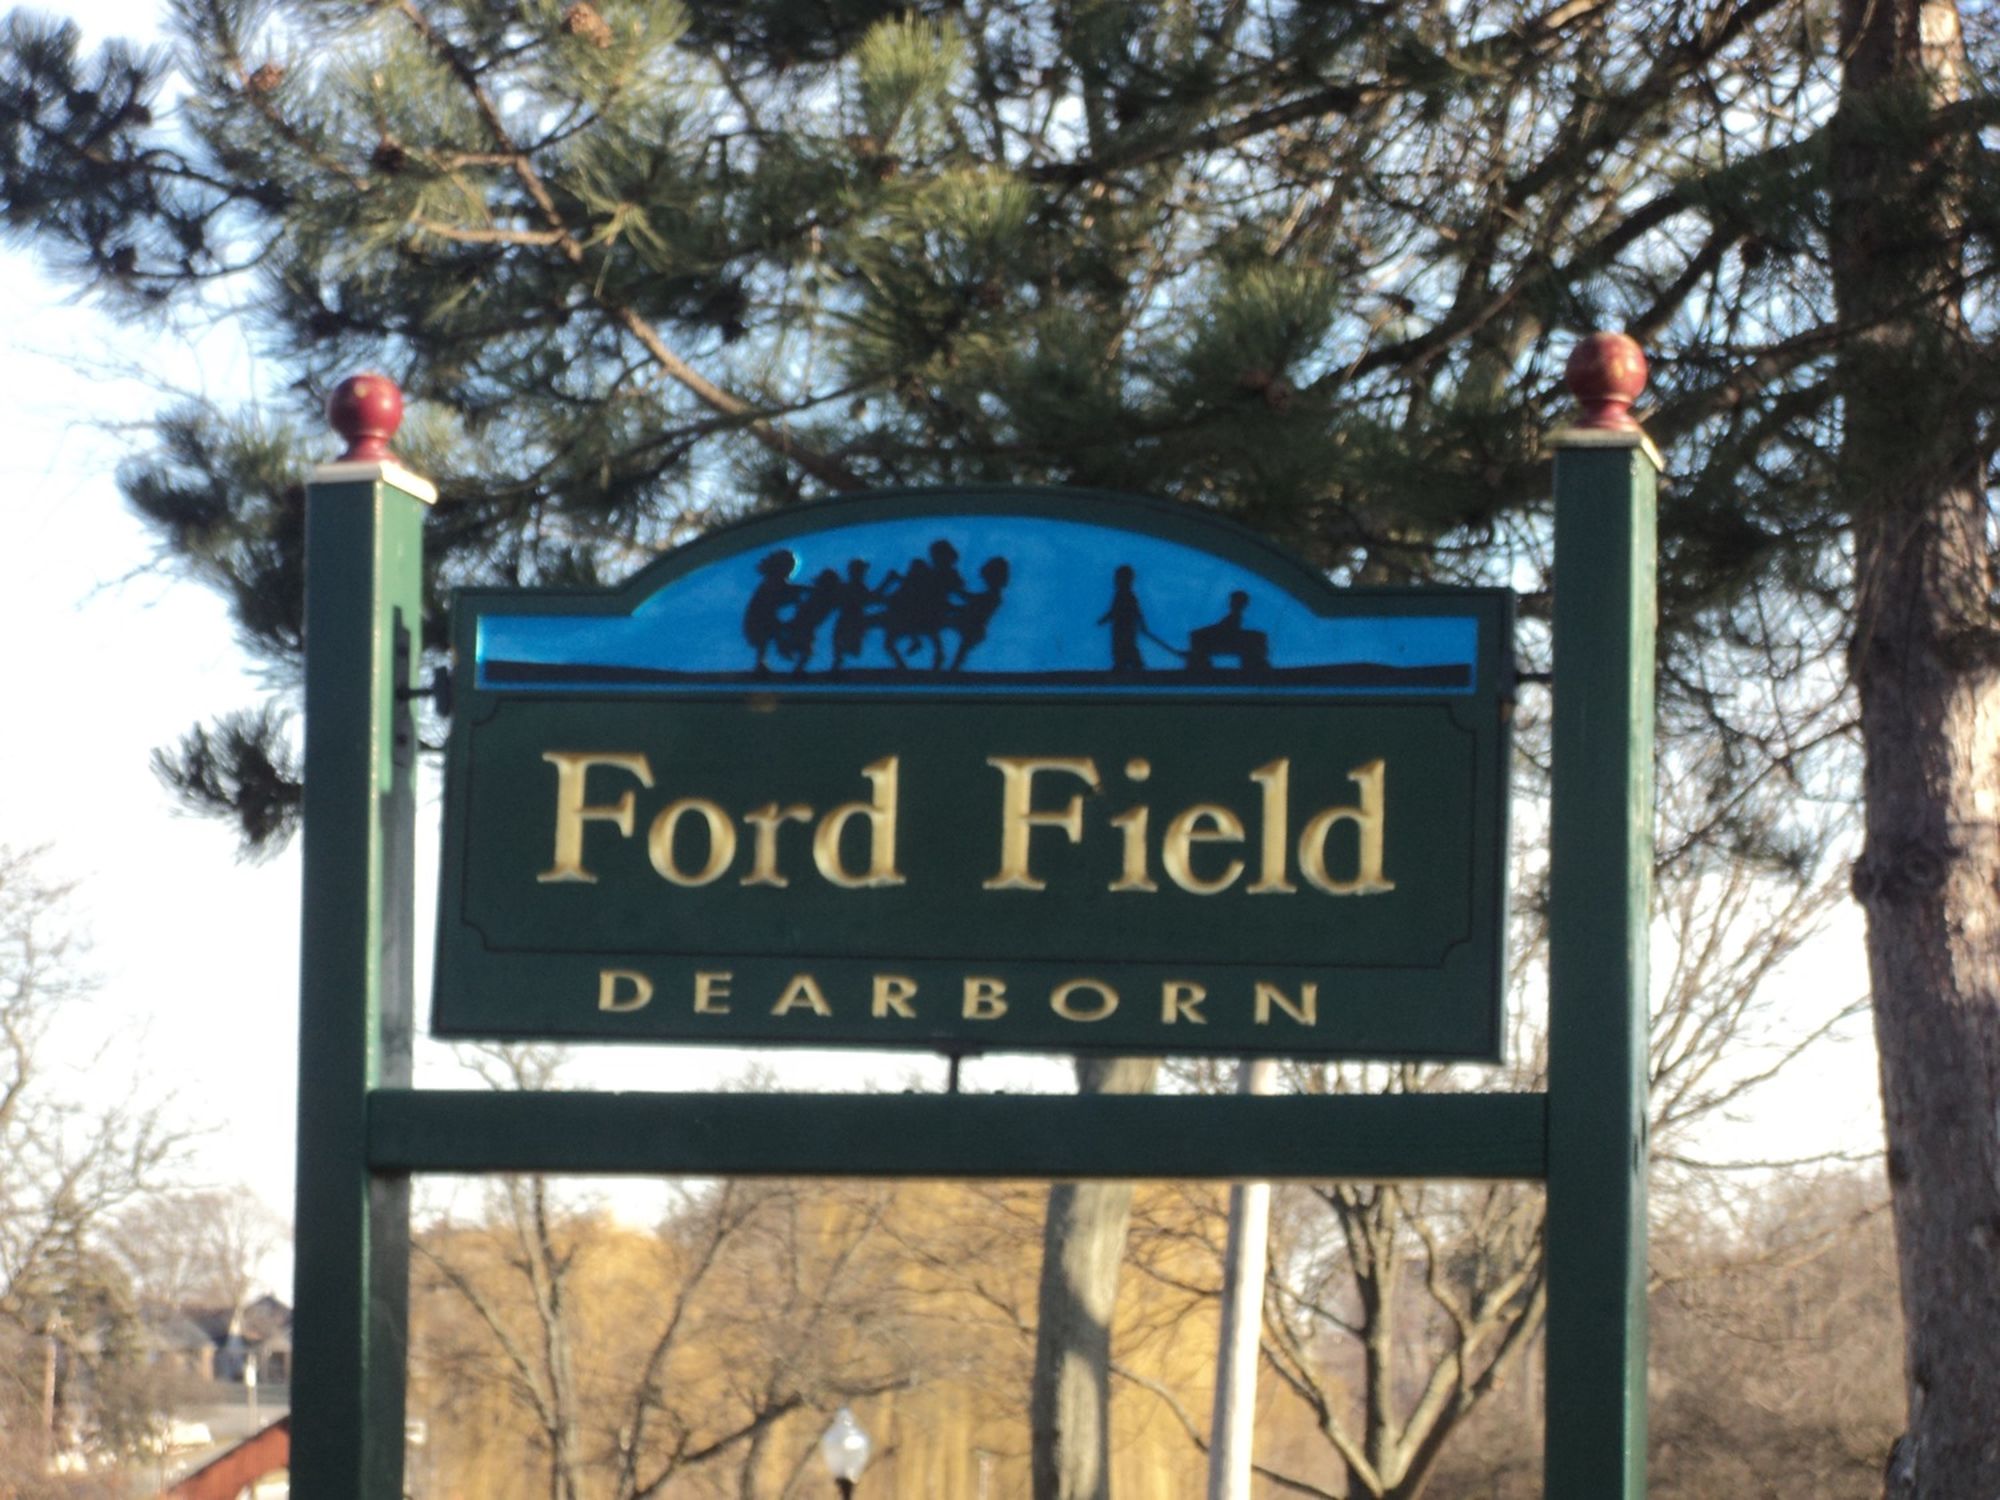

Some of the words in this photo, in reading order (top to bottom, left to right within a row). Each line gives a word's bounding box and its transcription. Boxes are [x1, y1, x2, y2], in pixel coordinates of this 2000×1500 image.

[536, 749, 906, 890] Ford
[982, 755, 1396, 897] Field
[597, 969, 1320, 1027] DEARBORN
